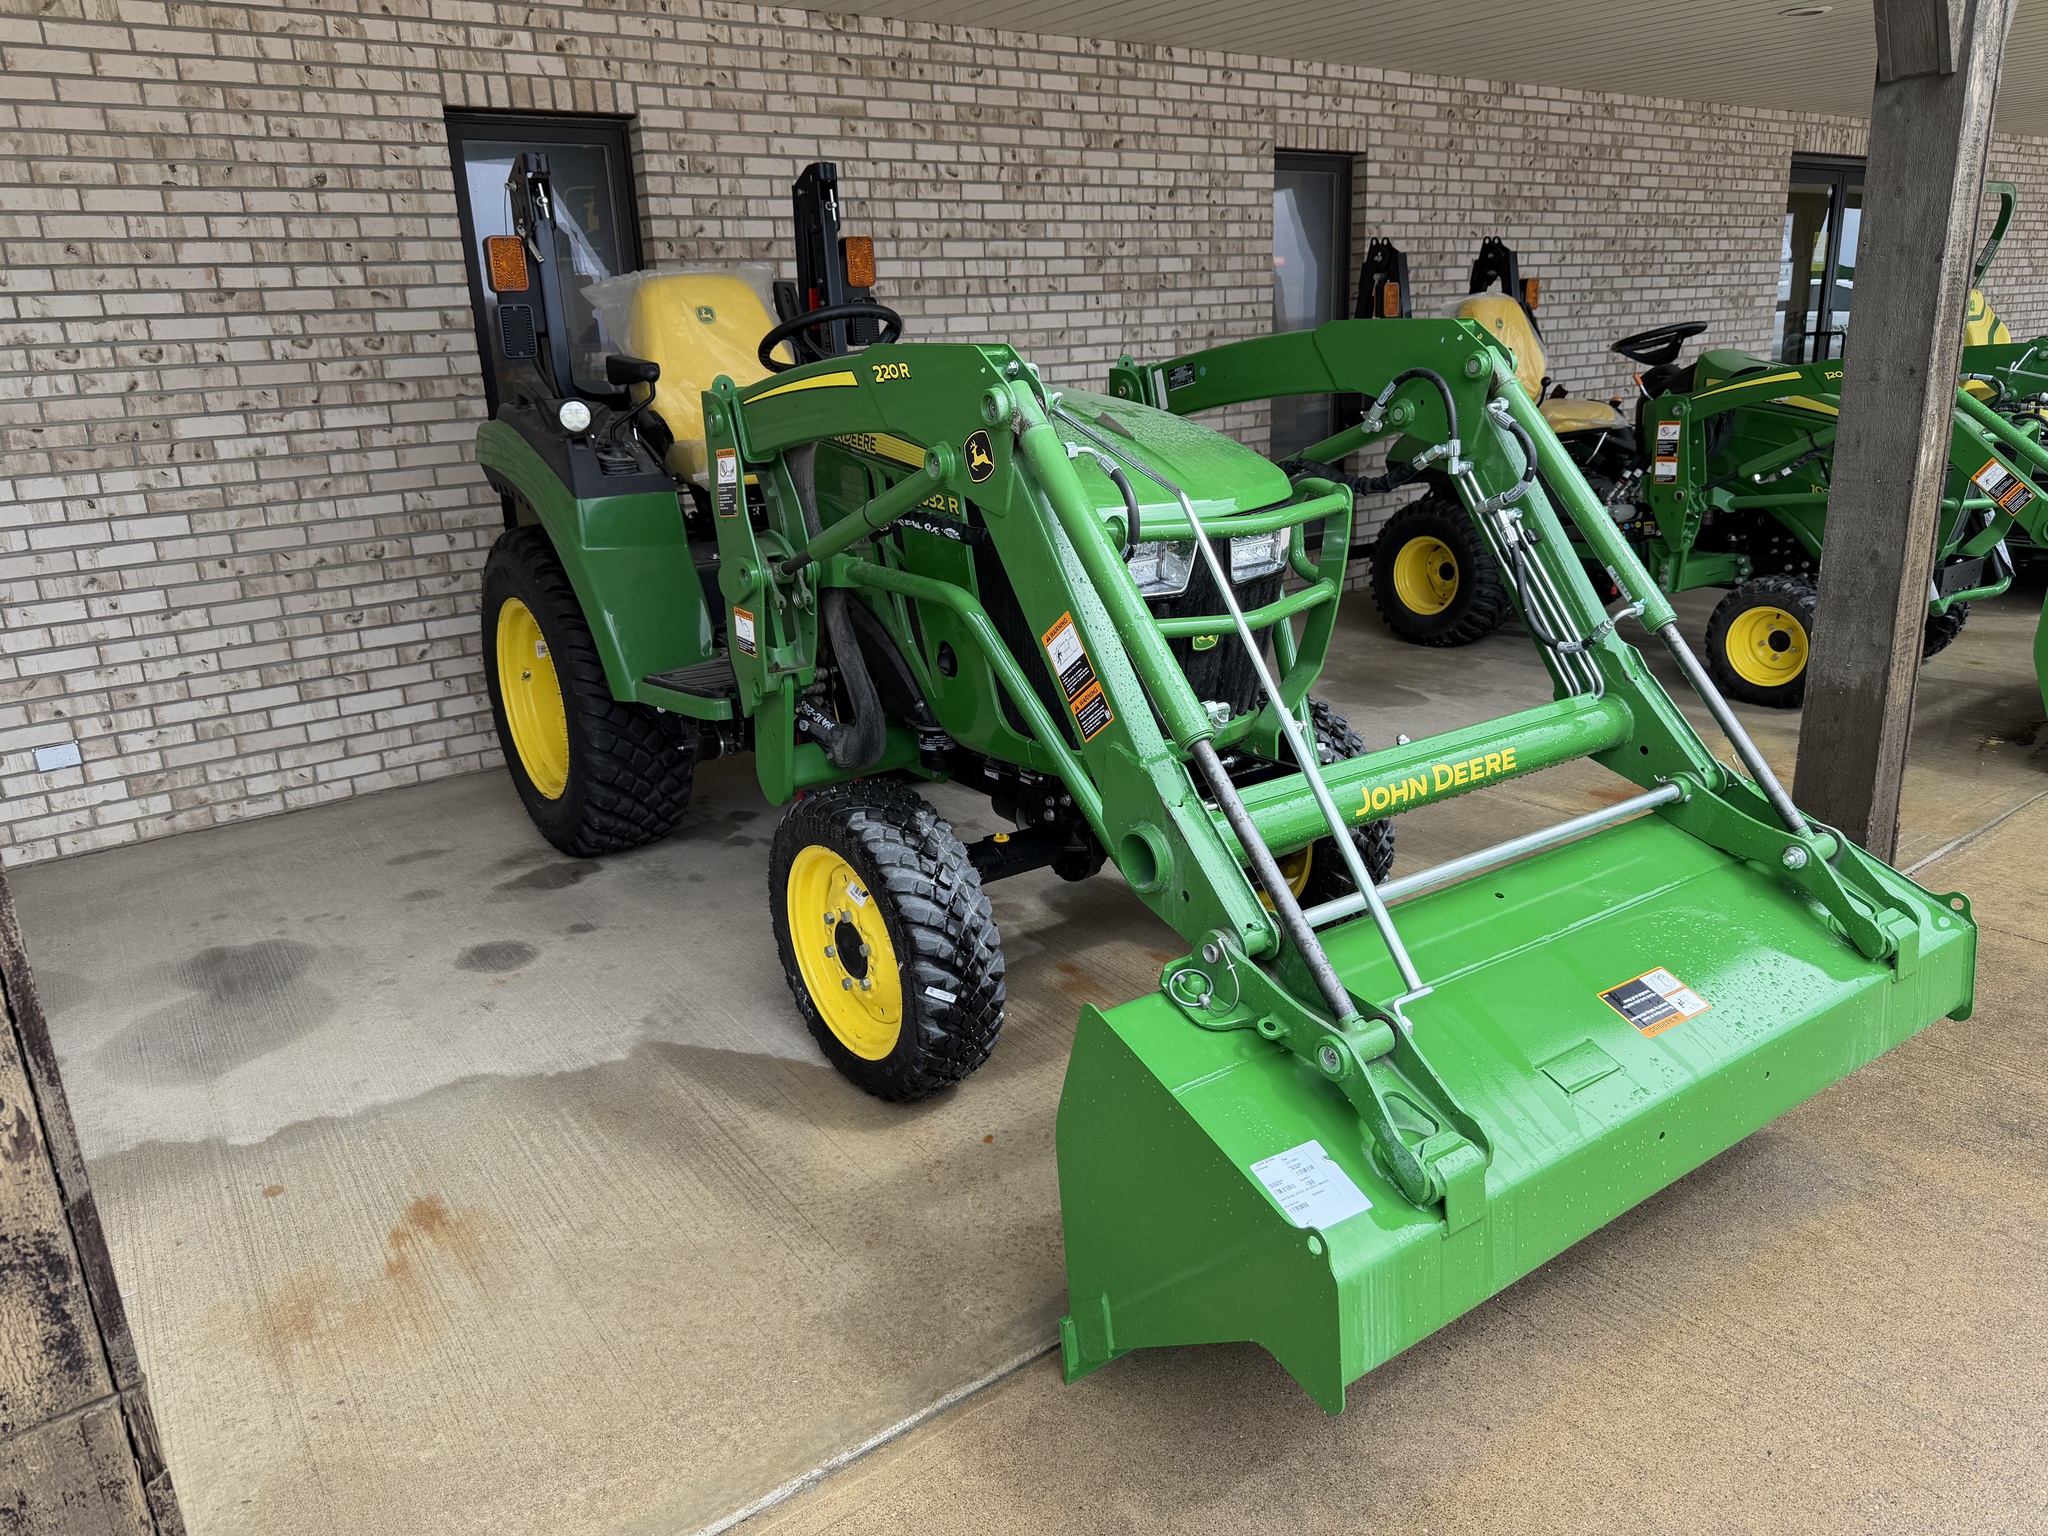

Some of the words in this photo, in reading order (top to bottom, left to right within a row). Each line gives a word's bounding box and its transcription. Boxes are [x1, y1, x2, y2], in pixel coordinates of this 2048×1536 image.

[1049, 617, 1068, 638] WARNING
[1078, 686, 1098, 707] WARNING
[1355, 774, 1428, 817] JOHN
[1431, 747, 1517, 792] DEERE
